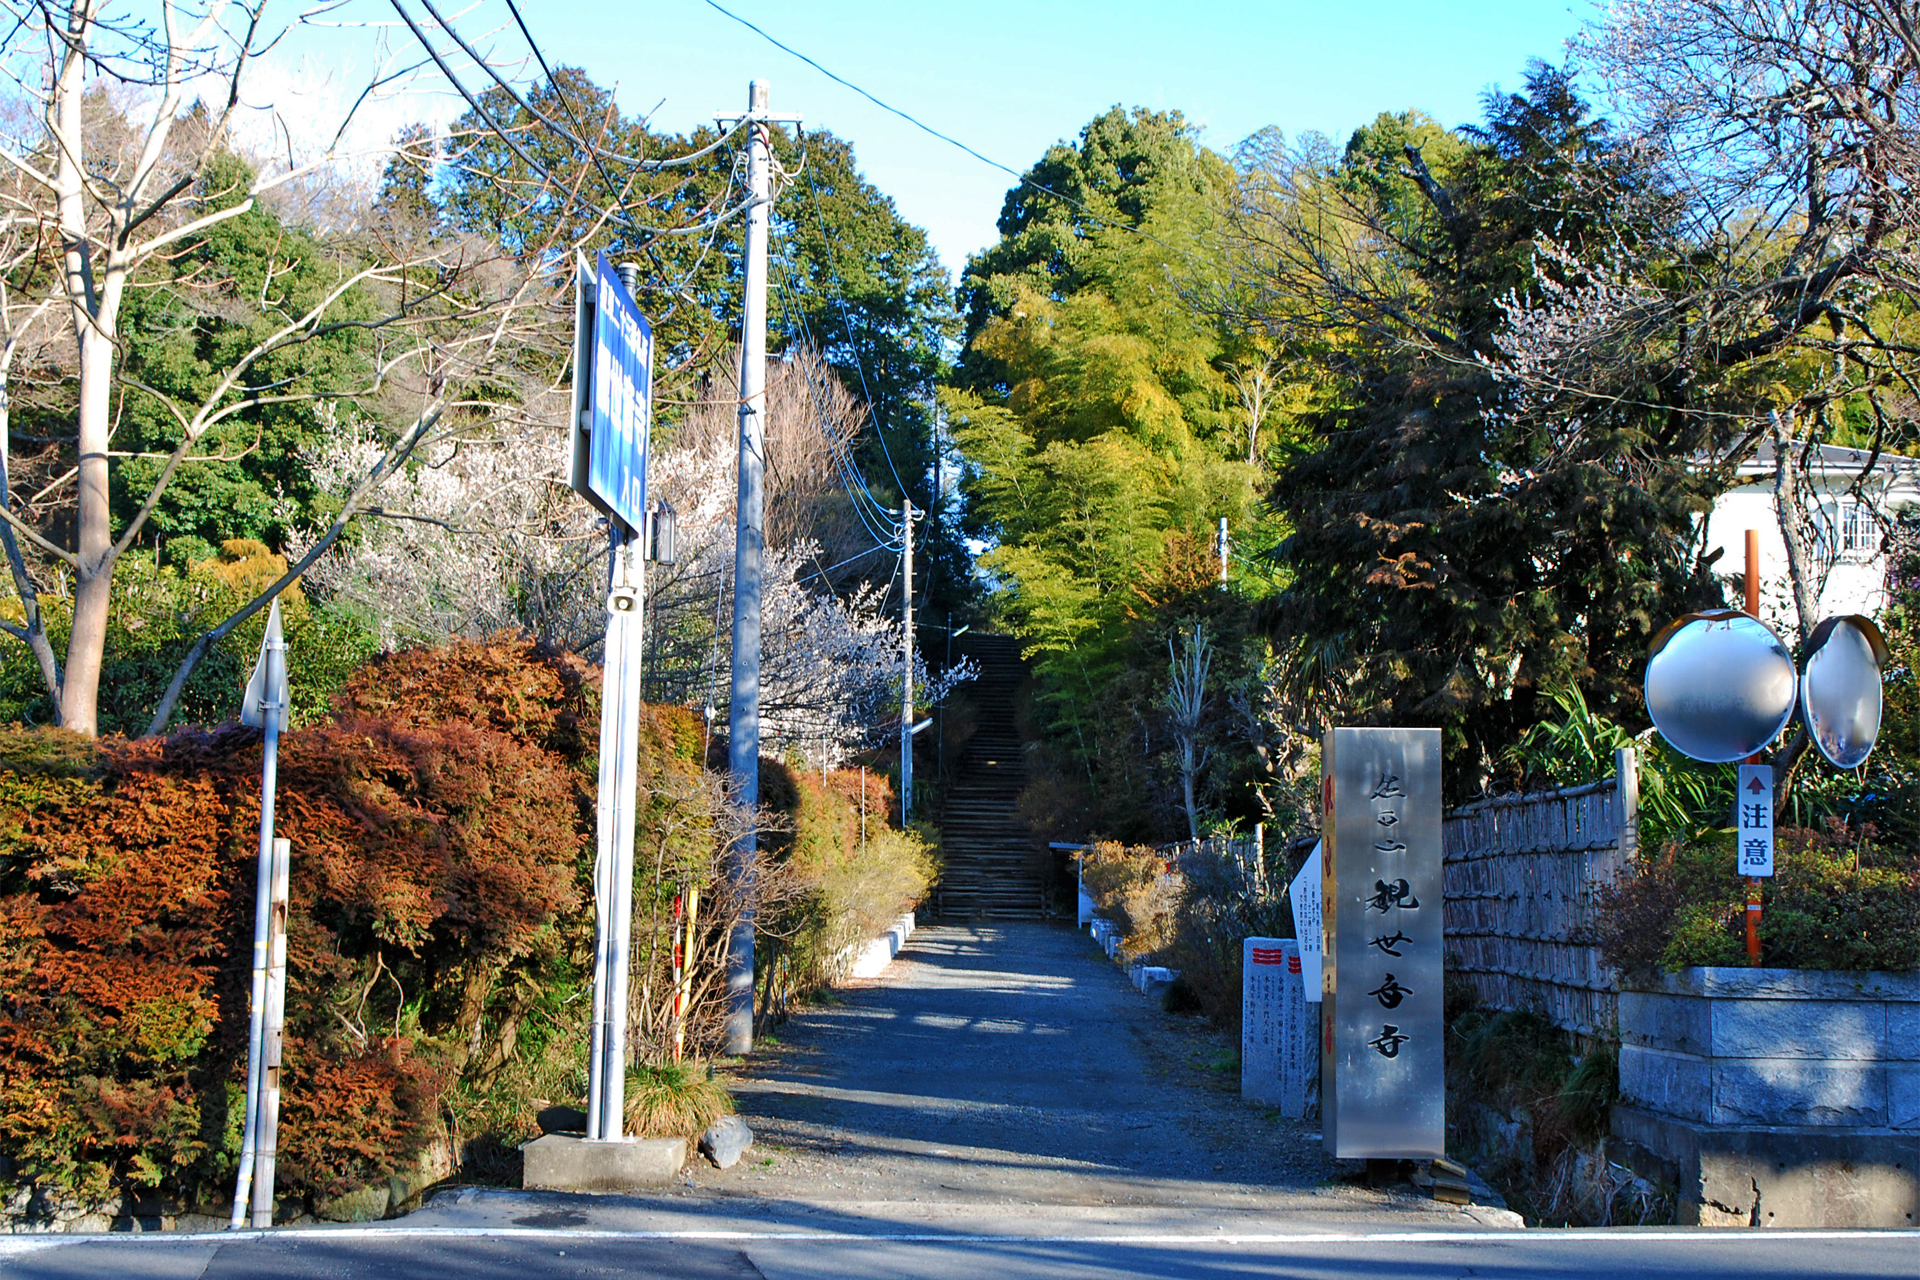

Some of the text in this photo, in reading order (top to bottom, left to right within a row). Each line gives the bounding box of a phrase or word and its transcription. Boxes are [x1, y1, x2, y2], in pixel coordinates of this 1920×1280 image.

[595, 343, 647, 456] 観世音寺
[621, 465, 640, 515] 入口
[1743, 803, 1768, 866] 注意
